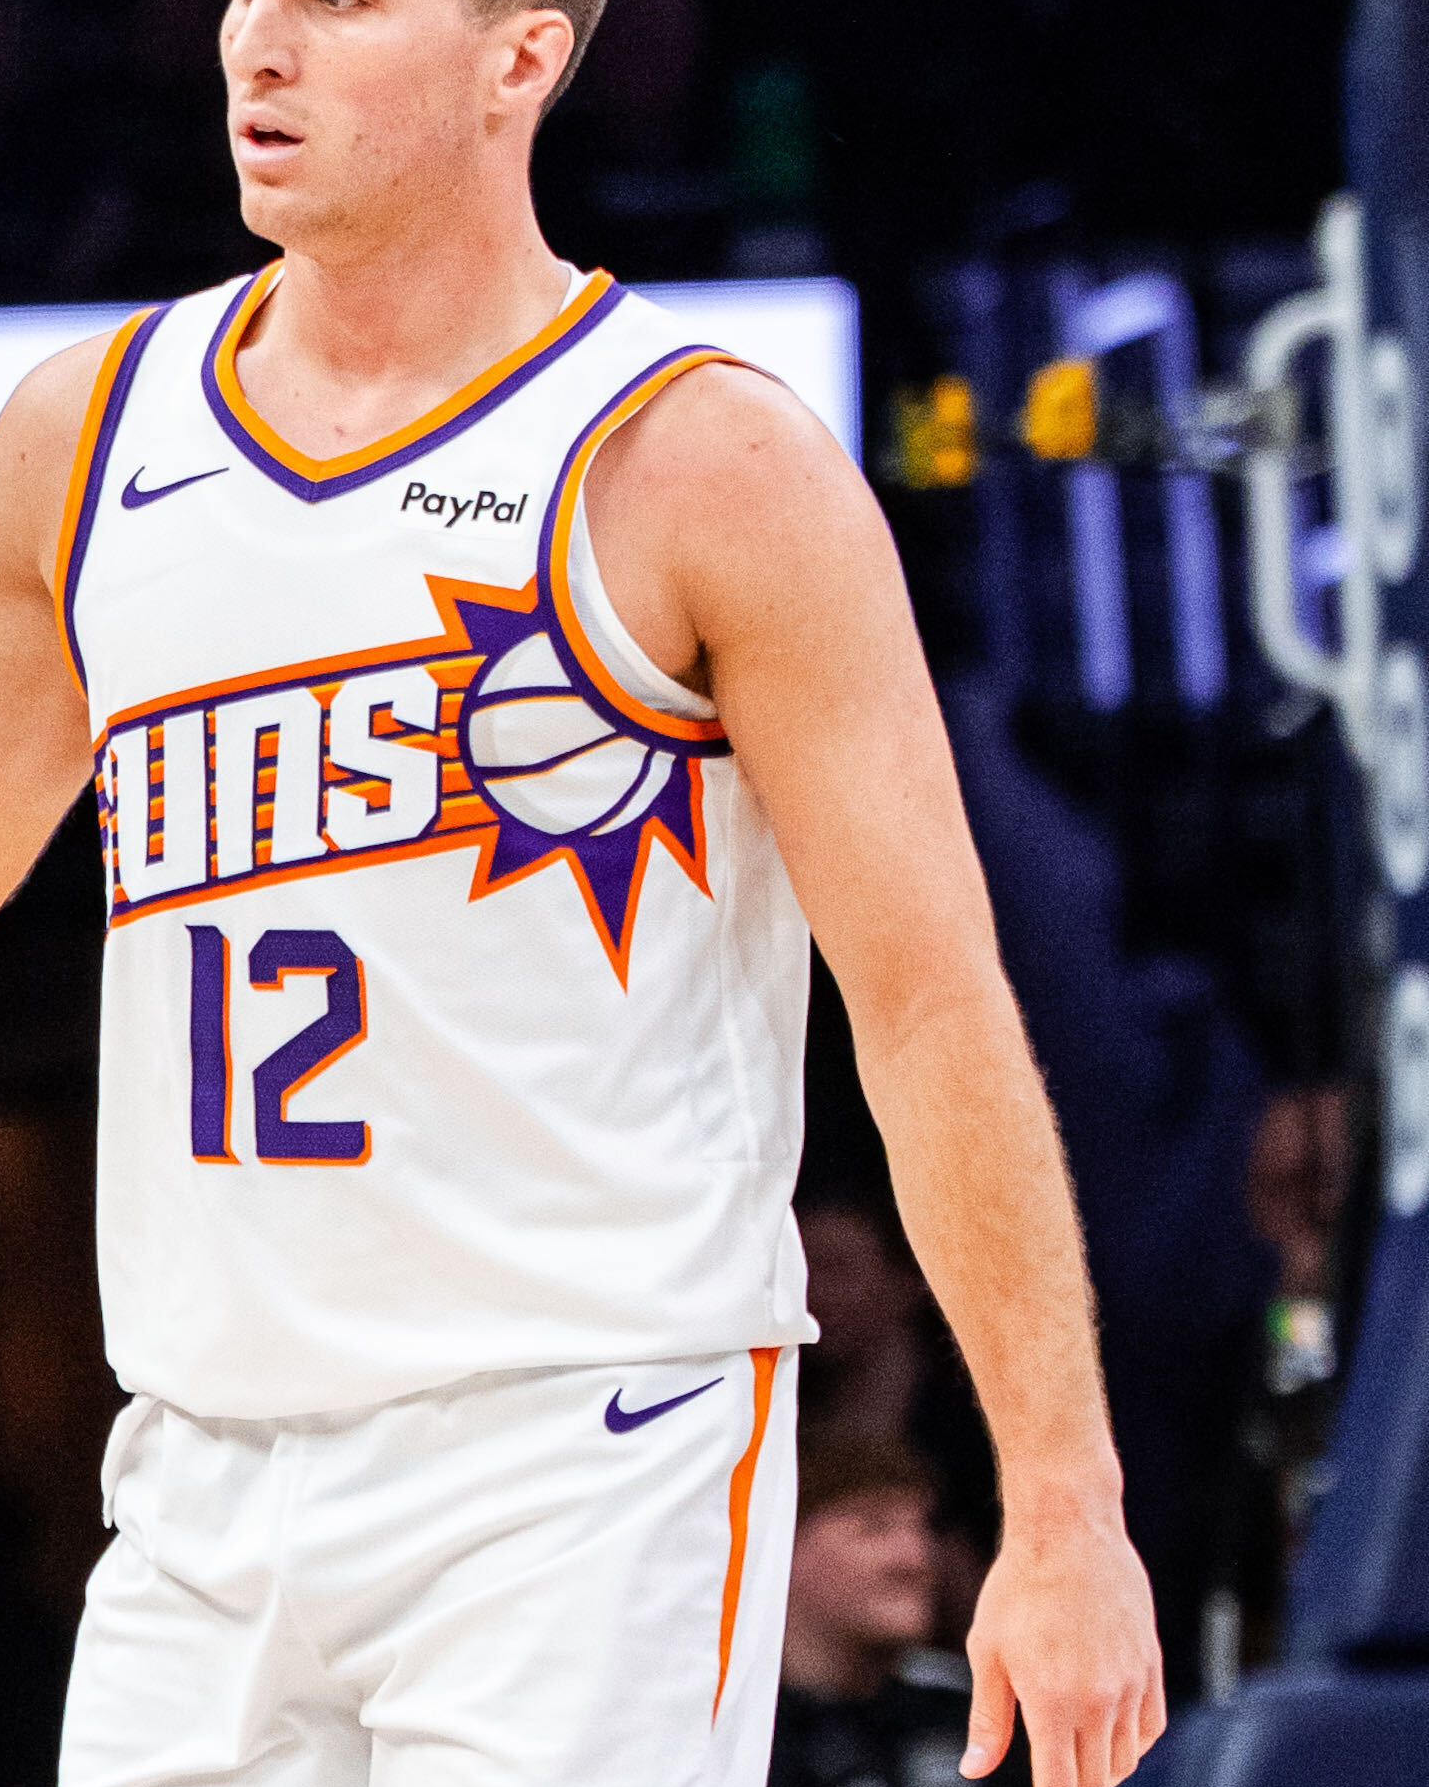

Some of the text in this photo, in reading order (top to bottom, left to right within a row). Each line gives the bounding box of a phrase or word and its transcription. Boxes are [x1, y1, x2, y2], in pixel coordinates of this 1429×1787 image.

[400, 481, 530, 529] PayPal
[102, 666, 439, 918] UNS
[185, 924, 372, 1166] 12
